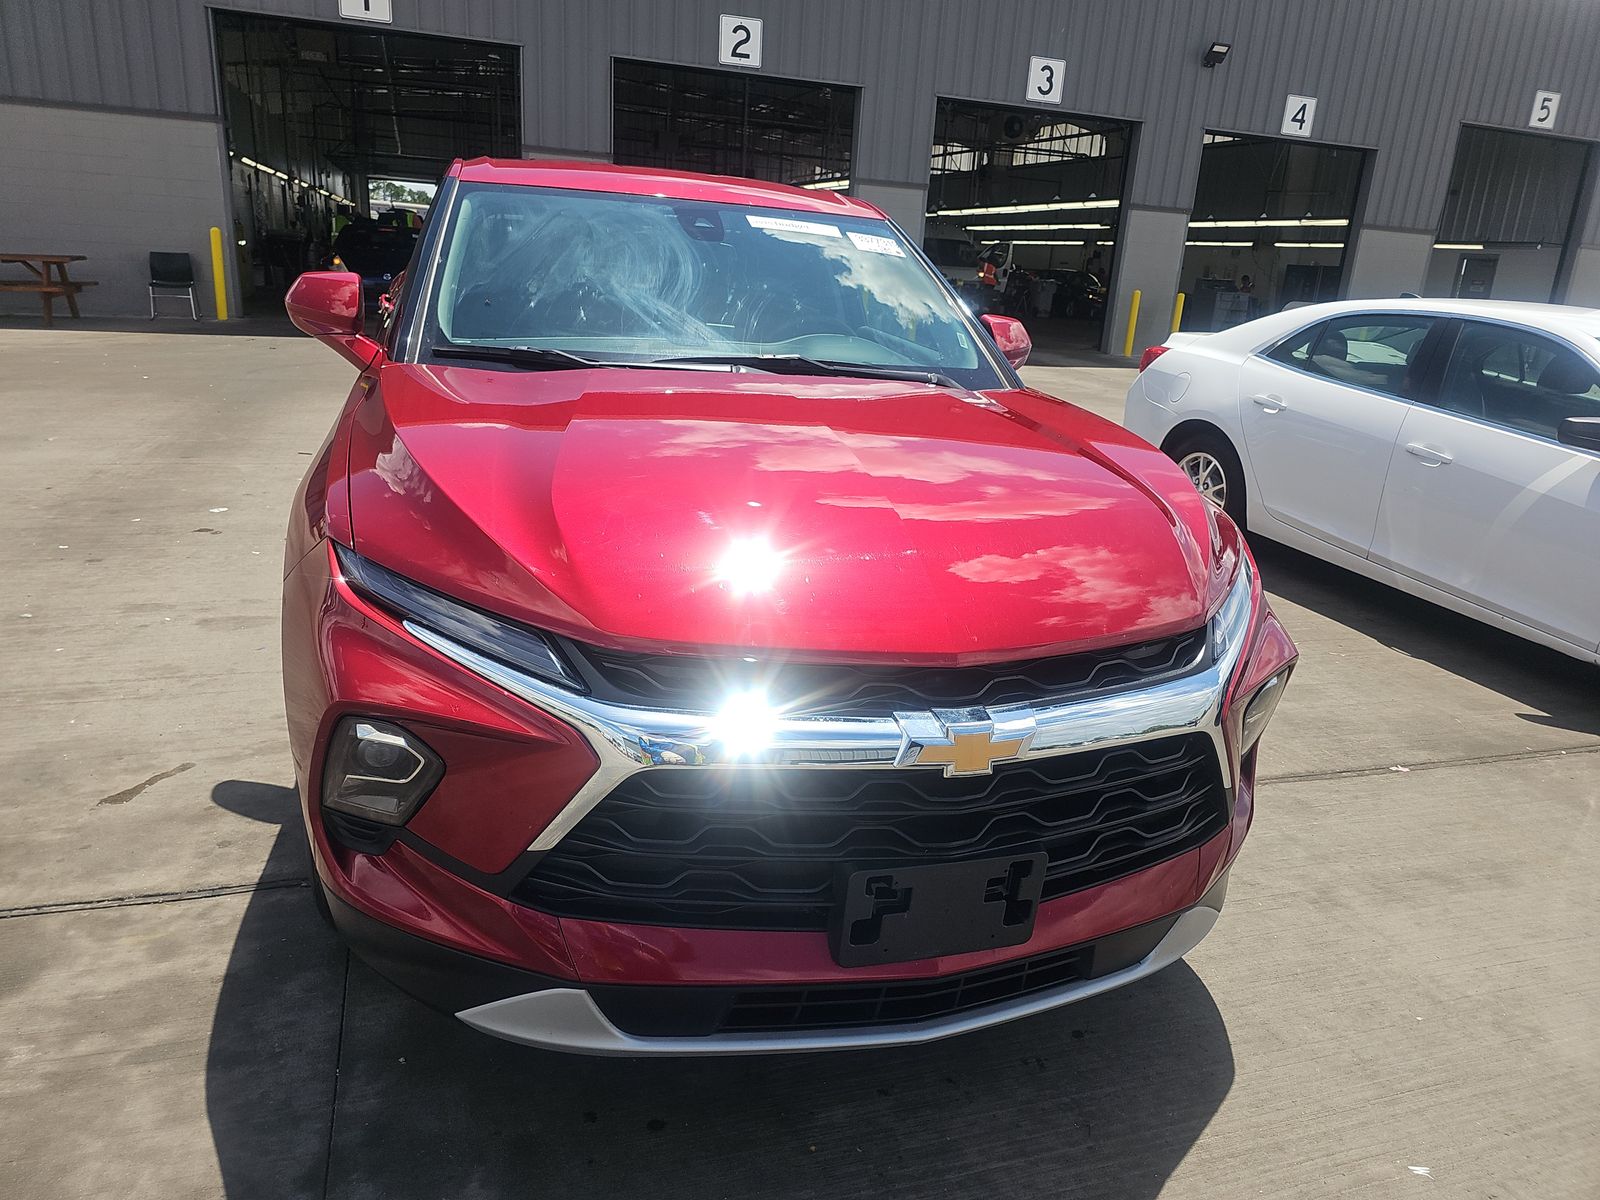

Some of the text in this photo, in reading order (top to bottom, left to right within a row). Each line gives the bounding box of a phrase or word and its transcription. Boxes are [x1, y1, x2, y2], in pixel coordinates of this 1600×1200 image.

[730, 24, 751, 60] 2
[1037, 64, 1054, 96] 3
[1290, 103, 1307, 131] 4
[1537, 97, 1553, 123] 5
